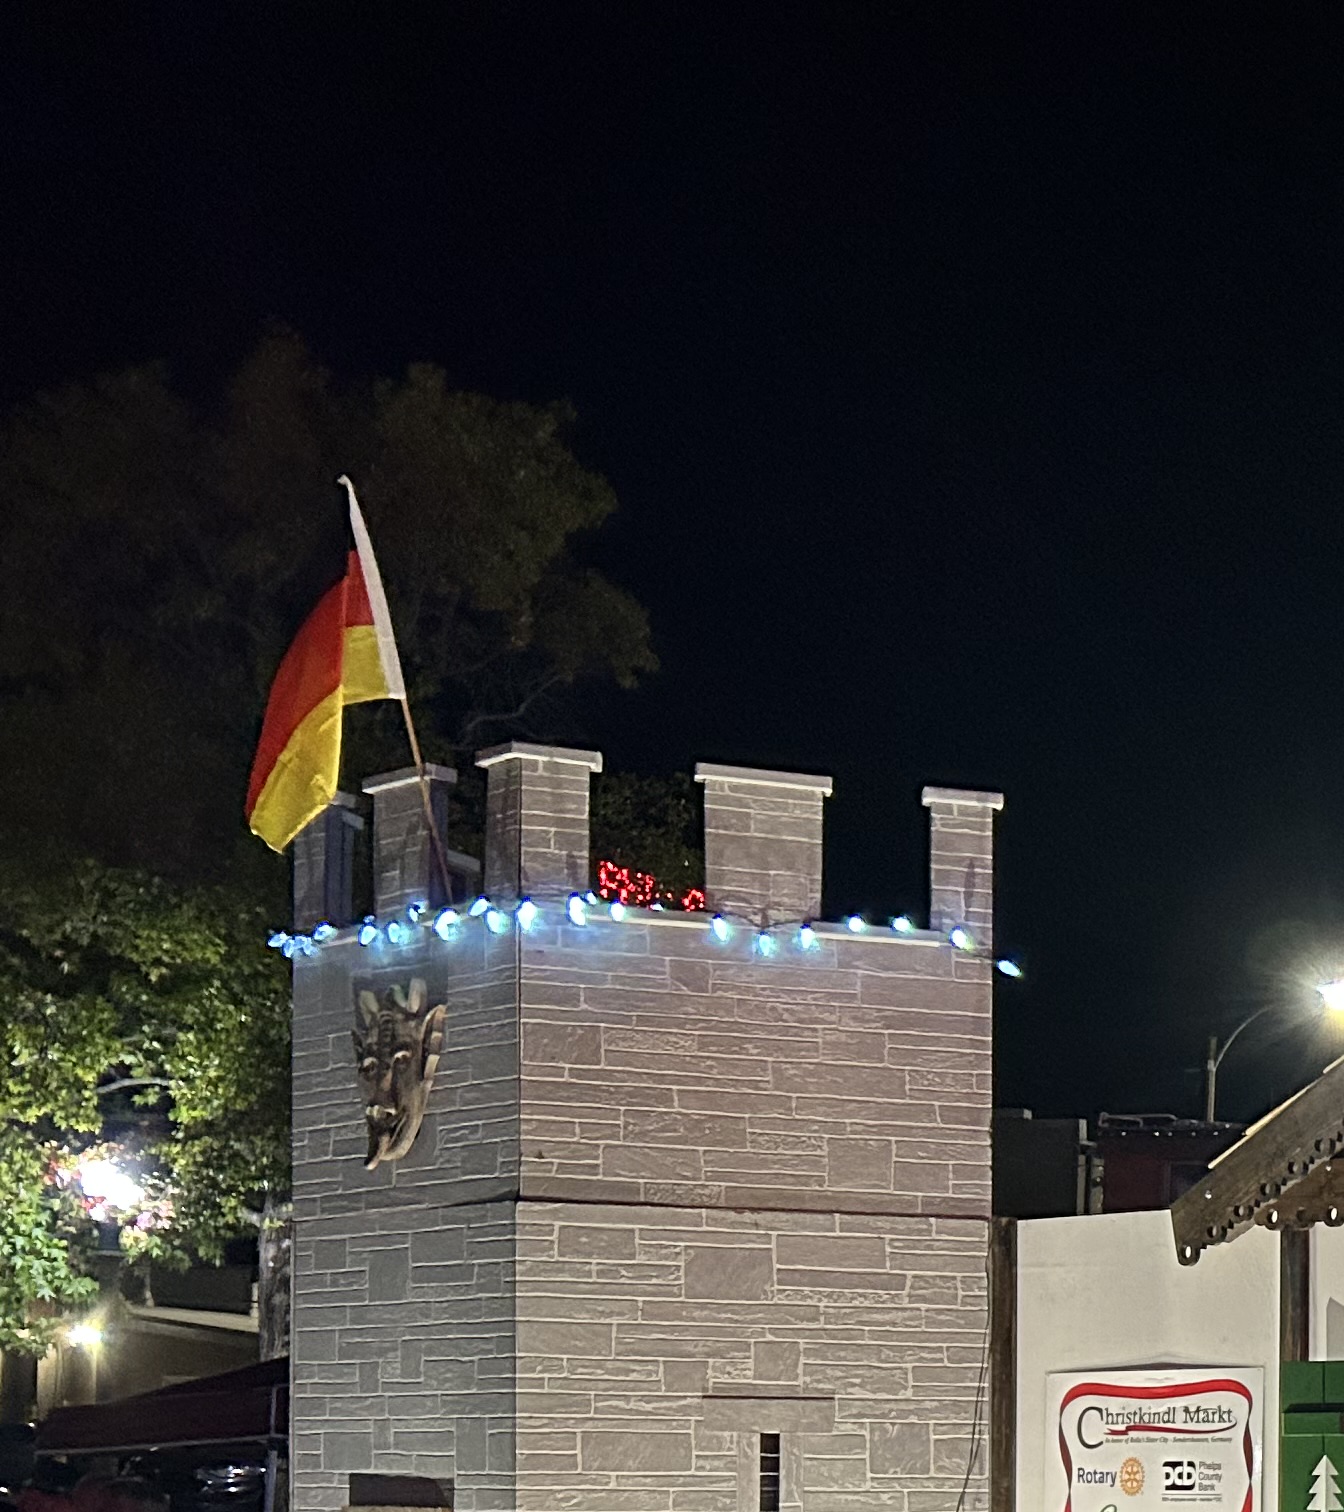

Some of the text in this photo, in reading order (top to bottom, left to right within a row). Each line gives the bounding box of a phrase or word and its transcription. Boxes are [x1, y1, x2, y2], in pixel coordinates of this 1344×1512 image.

[1077, 1405, 1233, 1449] Christkindl Markt
[1077, 1467, 1117, 1488] Rotary
[1199, 1472, 1222, 1482] County
[1199, 1482, 1215, 1491] Bank
